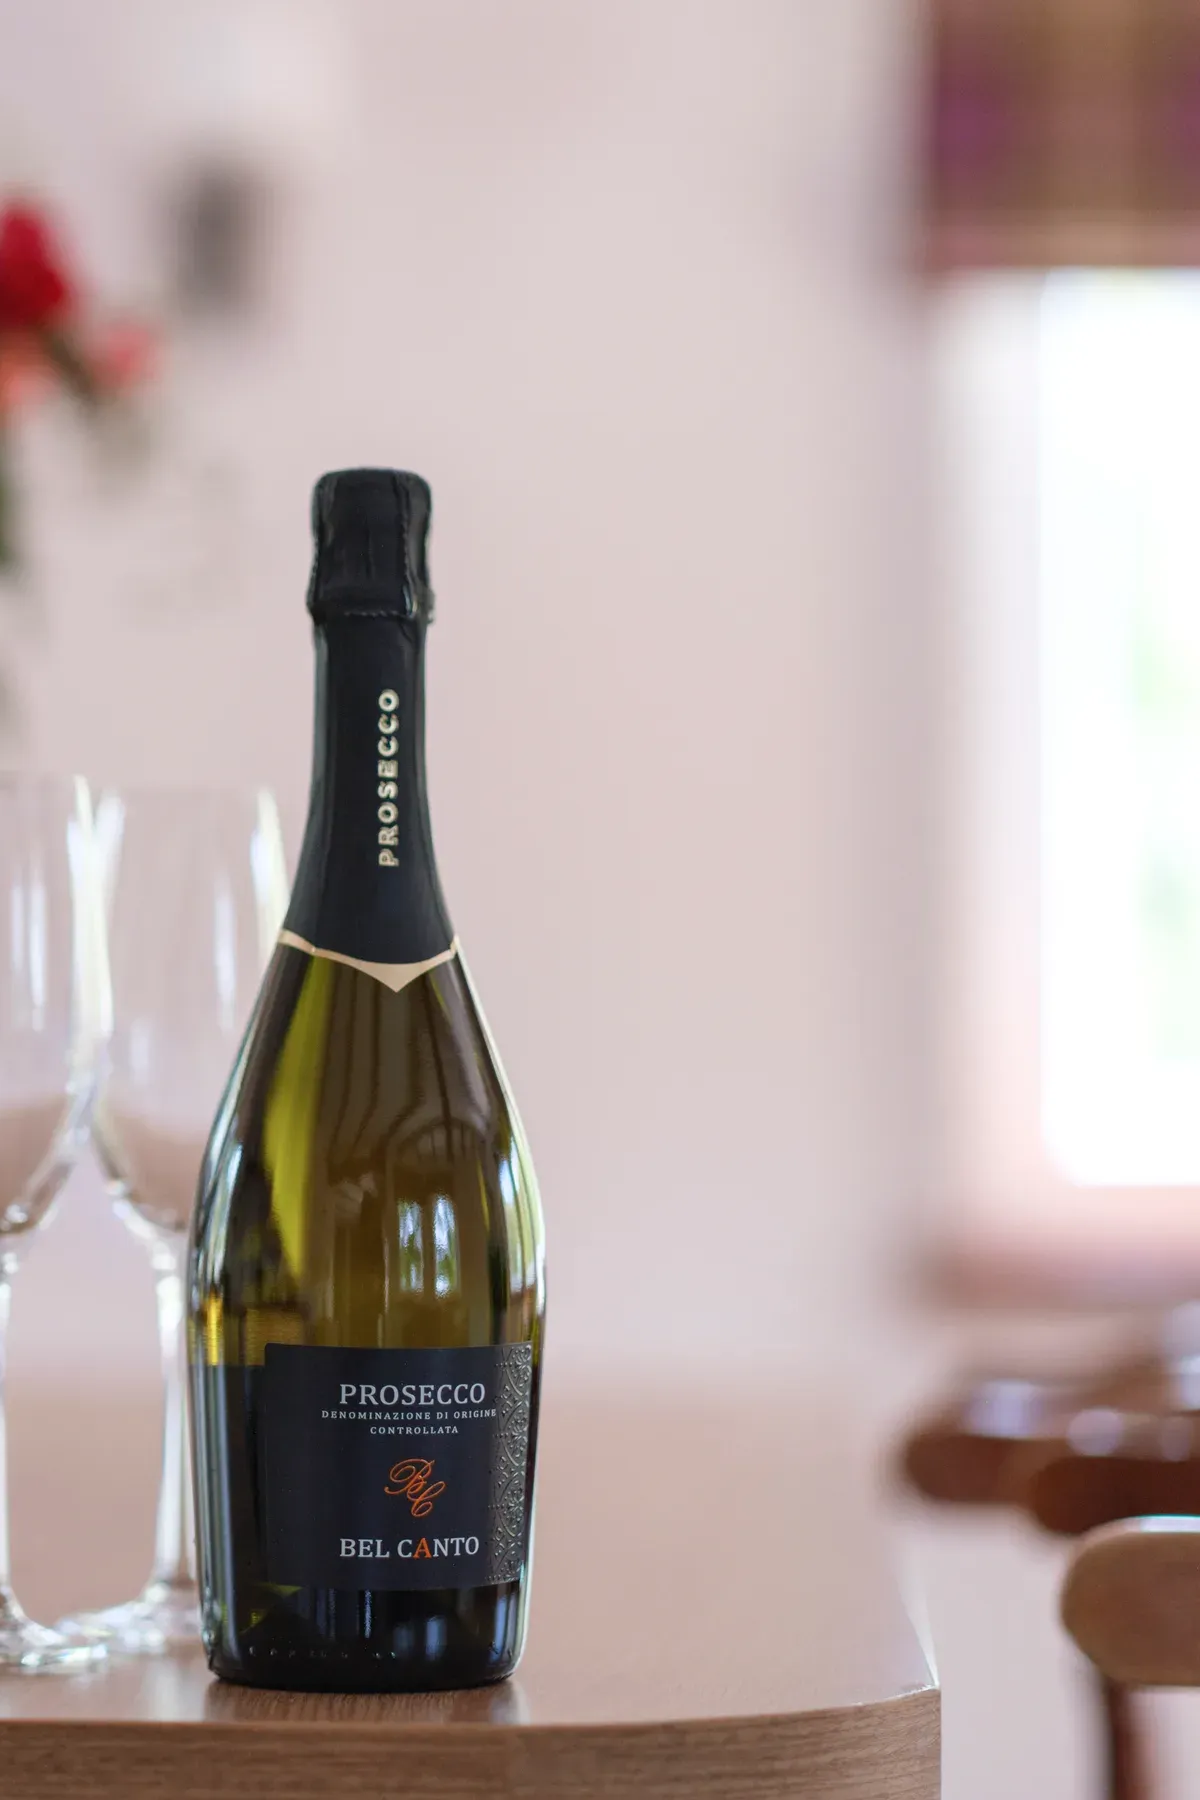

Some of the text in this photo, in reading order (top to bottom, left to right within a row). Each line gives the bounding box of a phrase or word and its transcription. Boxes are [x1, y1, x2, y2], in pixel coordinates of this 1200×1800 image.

[378, 688, 400, 867] PROSECCO
[339, 1383, 486, 1406] PROSECCO
[321, 1408, 497, 1420] DENOMINAZIONE DI ORIGINE
[370, 1426, 459, 1435] CONTROLLATA
[339, 1536, 480, 1559] BEL CANTO
